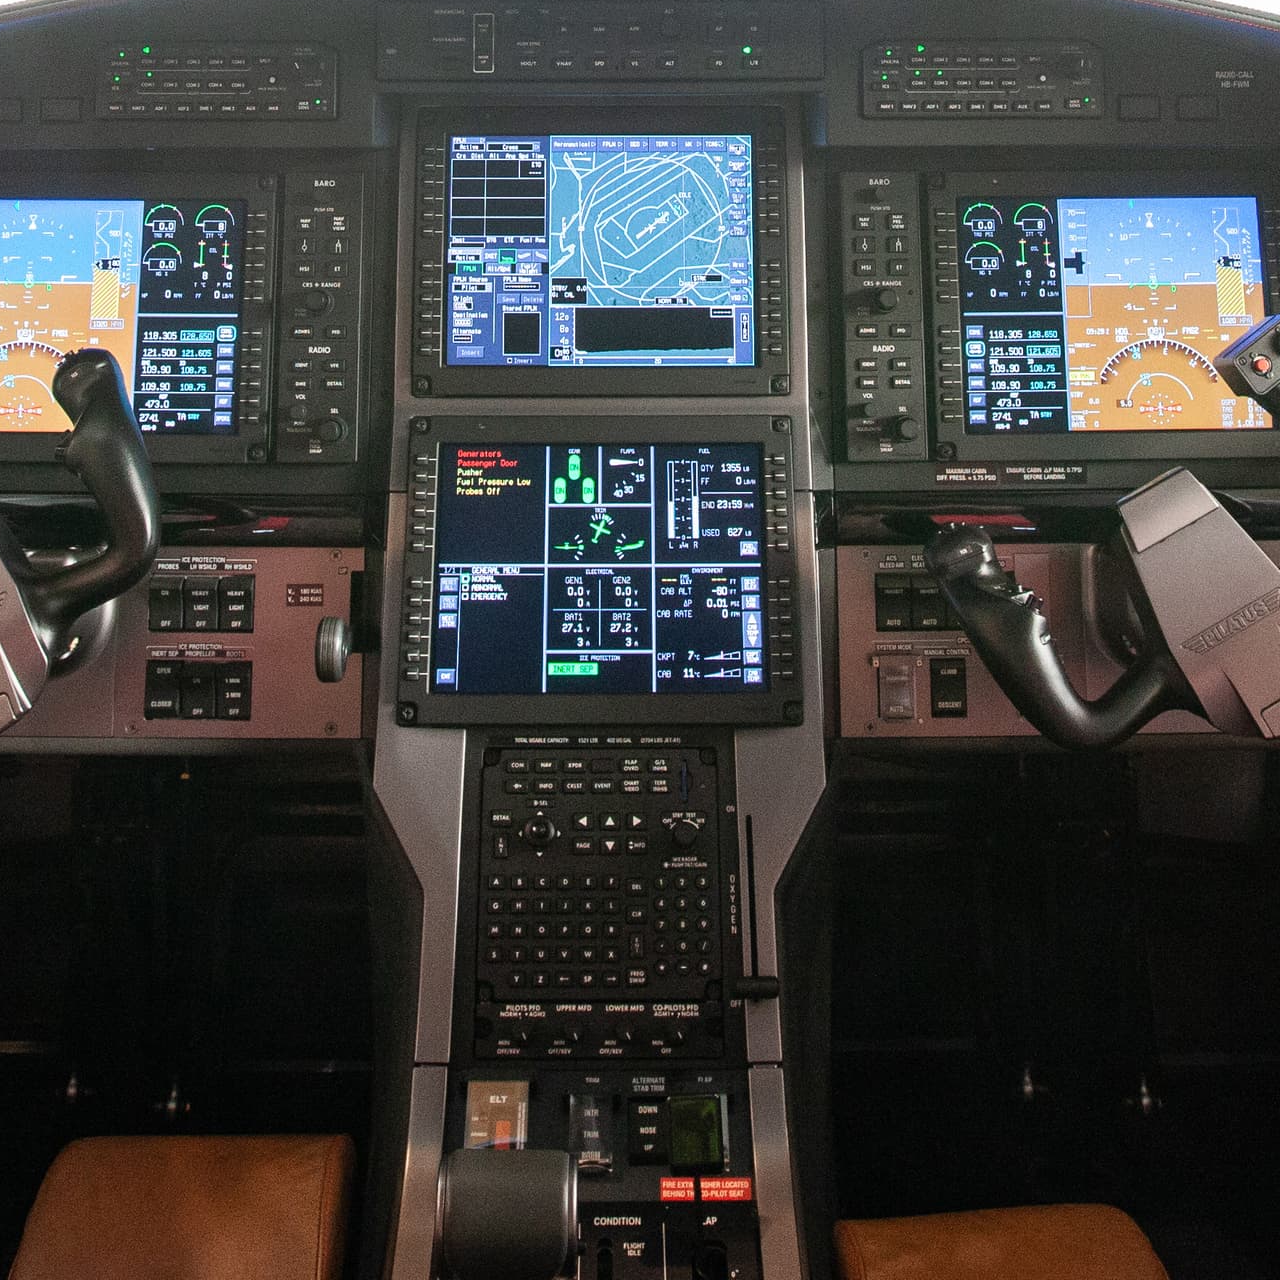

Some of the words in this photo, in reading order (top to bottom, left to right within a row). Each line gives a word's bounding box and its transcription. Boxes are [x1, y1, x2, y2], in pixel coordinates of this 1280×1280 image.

[144, 332, 178, 340] 118.305
[989, 330, 1023, 339] 118.305
[143, 349, 177, 357] 121.500
[142, 366, 171, 374] 109.90
[145, 400, 170, 408] 473.0
[140, 414, 159, 422] 2741
[458, 450, 502, 458] Generators
[458, 460, 497, 468] Passenger
[721, 464, 741, 473] 1355
[635, 474, 645, 482] 15
[624, 486, 634, 494] 30
[702, 501, 715, 509] END
[717, 500, 743, 509] 23:59
[707, 599, 728, 608] 0.01
[565, 613, 583, 621] BAT1
[613, 613, 631, 621] BAT2
[657, 610, 670, 618] CAB
[674, 610, 693, 618] RATE
[562, 623, 583, 633] 27.1
[610, 623, 632, 633] 27.2
[1200, 601, 1265, 650] PILATUS
[657, 653, 676, 661] CKPT
[729, 874, 738, 935] OXYGEN
[489, 1096, 508, 1104] ELT
[638, 1106, 658, 1114] DOWN
[640, 1127, 657, 1135] NOSE
[663, 1181, 676, 1189] FIRE
[663, 1190, 686, 1198] BEHIND
[594, 1217, 642, 1226] CONDITION
